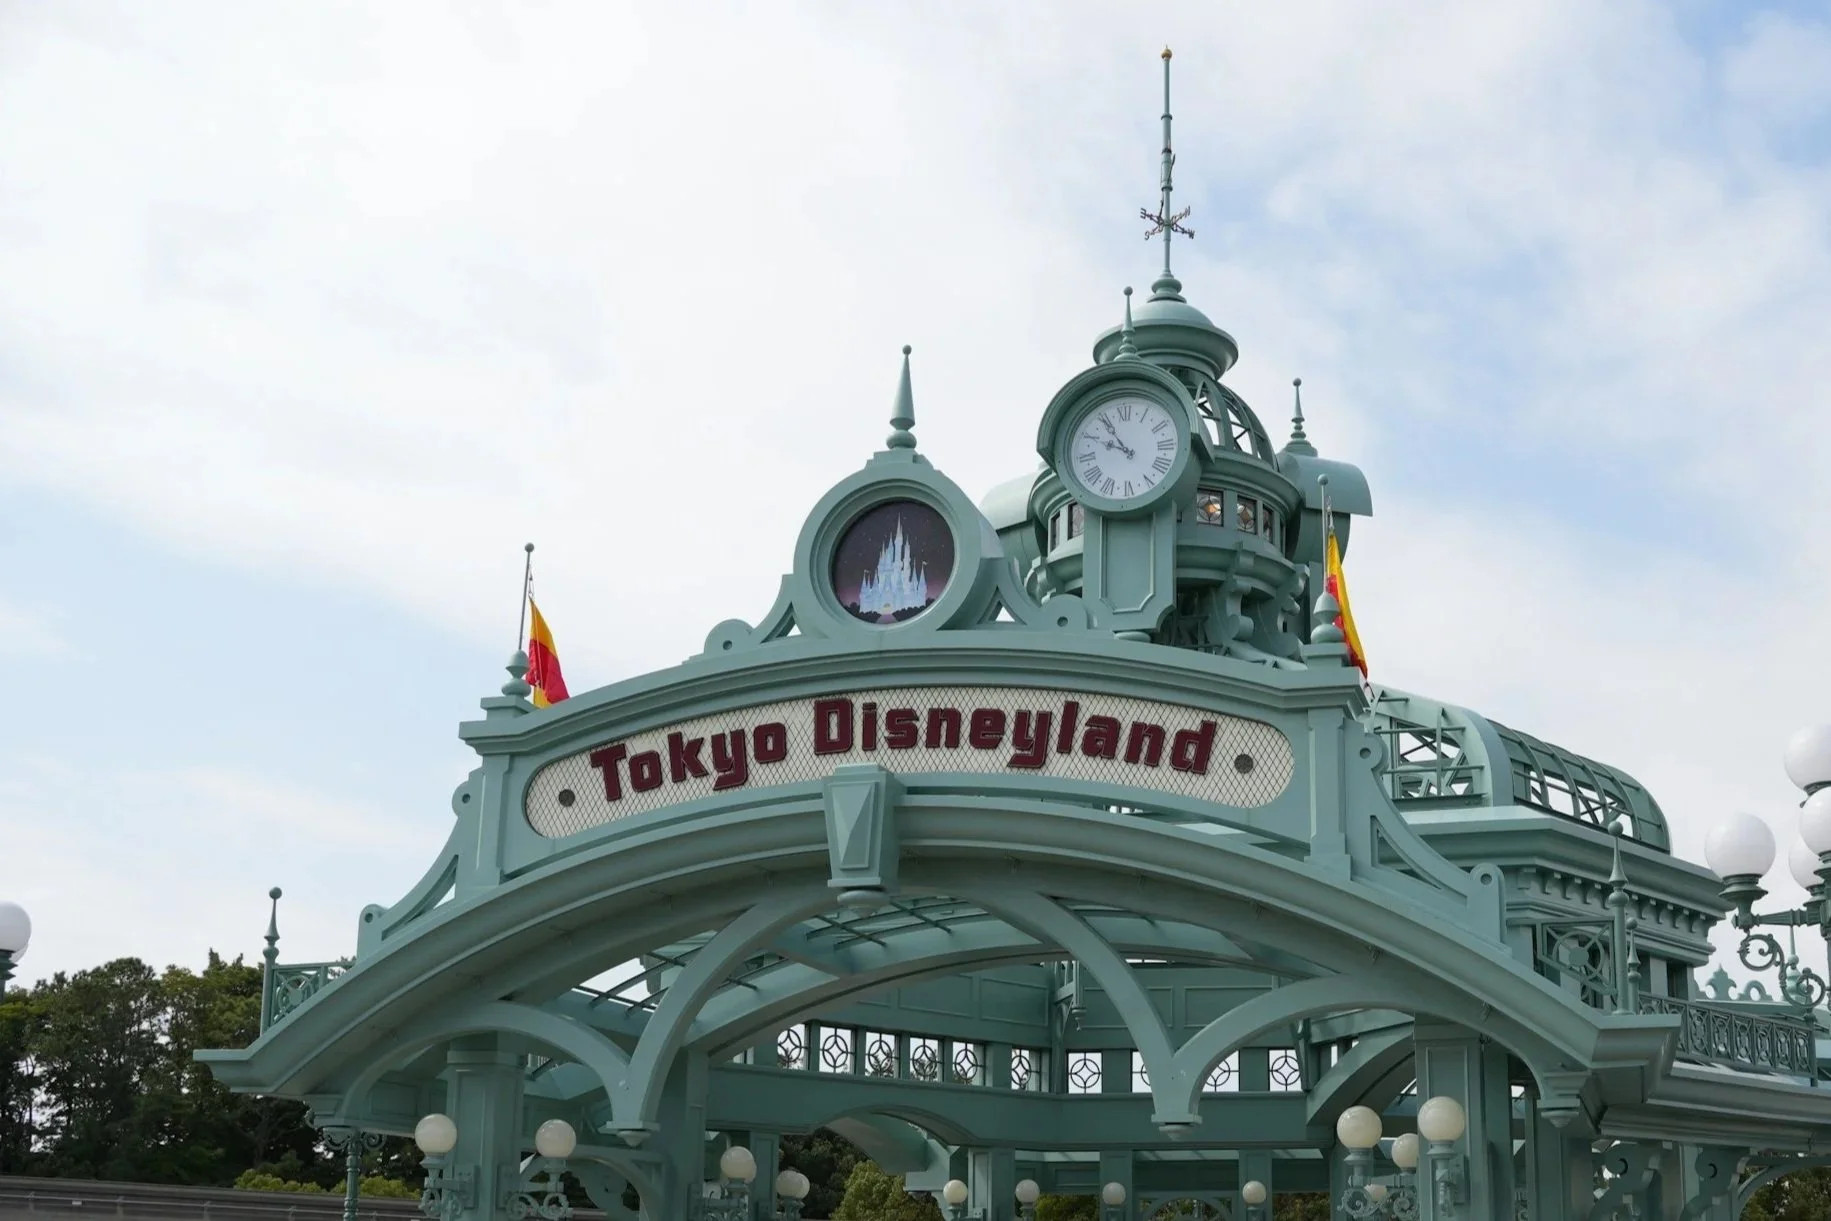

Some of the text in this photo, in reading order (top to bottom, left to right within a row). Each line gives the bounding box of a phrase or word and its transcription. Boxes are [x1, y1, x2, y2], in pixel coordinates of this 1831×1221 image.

[1117, 405, 1132, 422] XII
[1140, 407, 1149, 423] I
[1151, 420, 1168, 434] II
[1157, 438, 1174, 451] III
[590, 698, 1217, 801] Tokyo Disneyland
